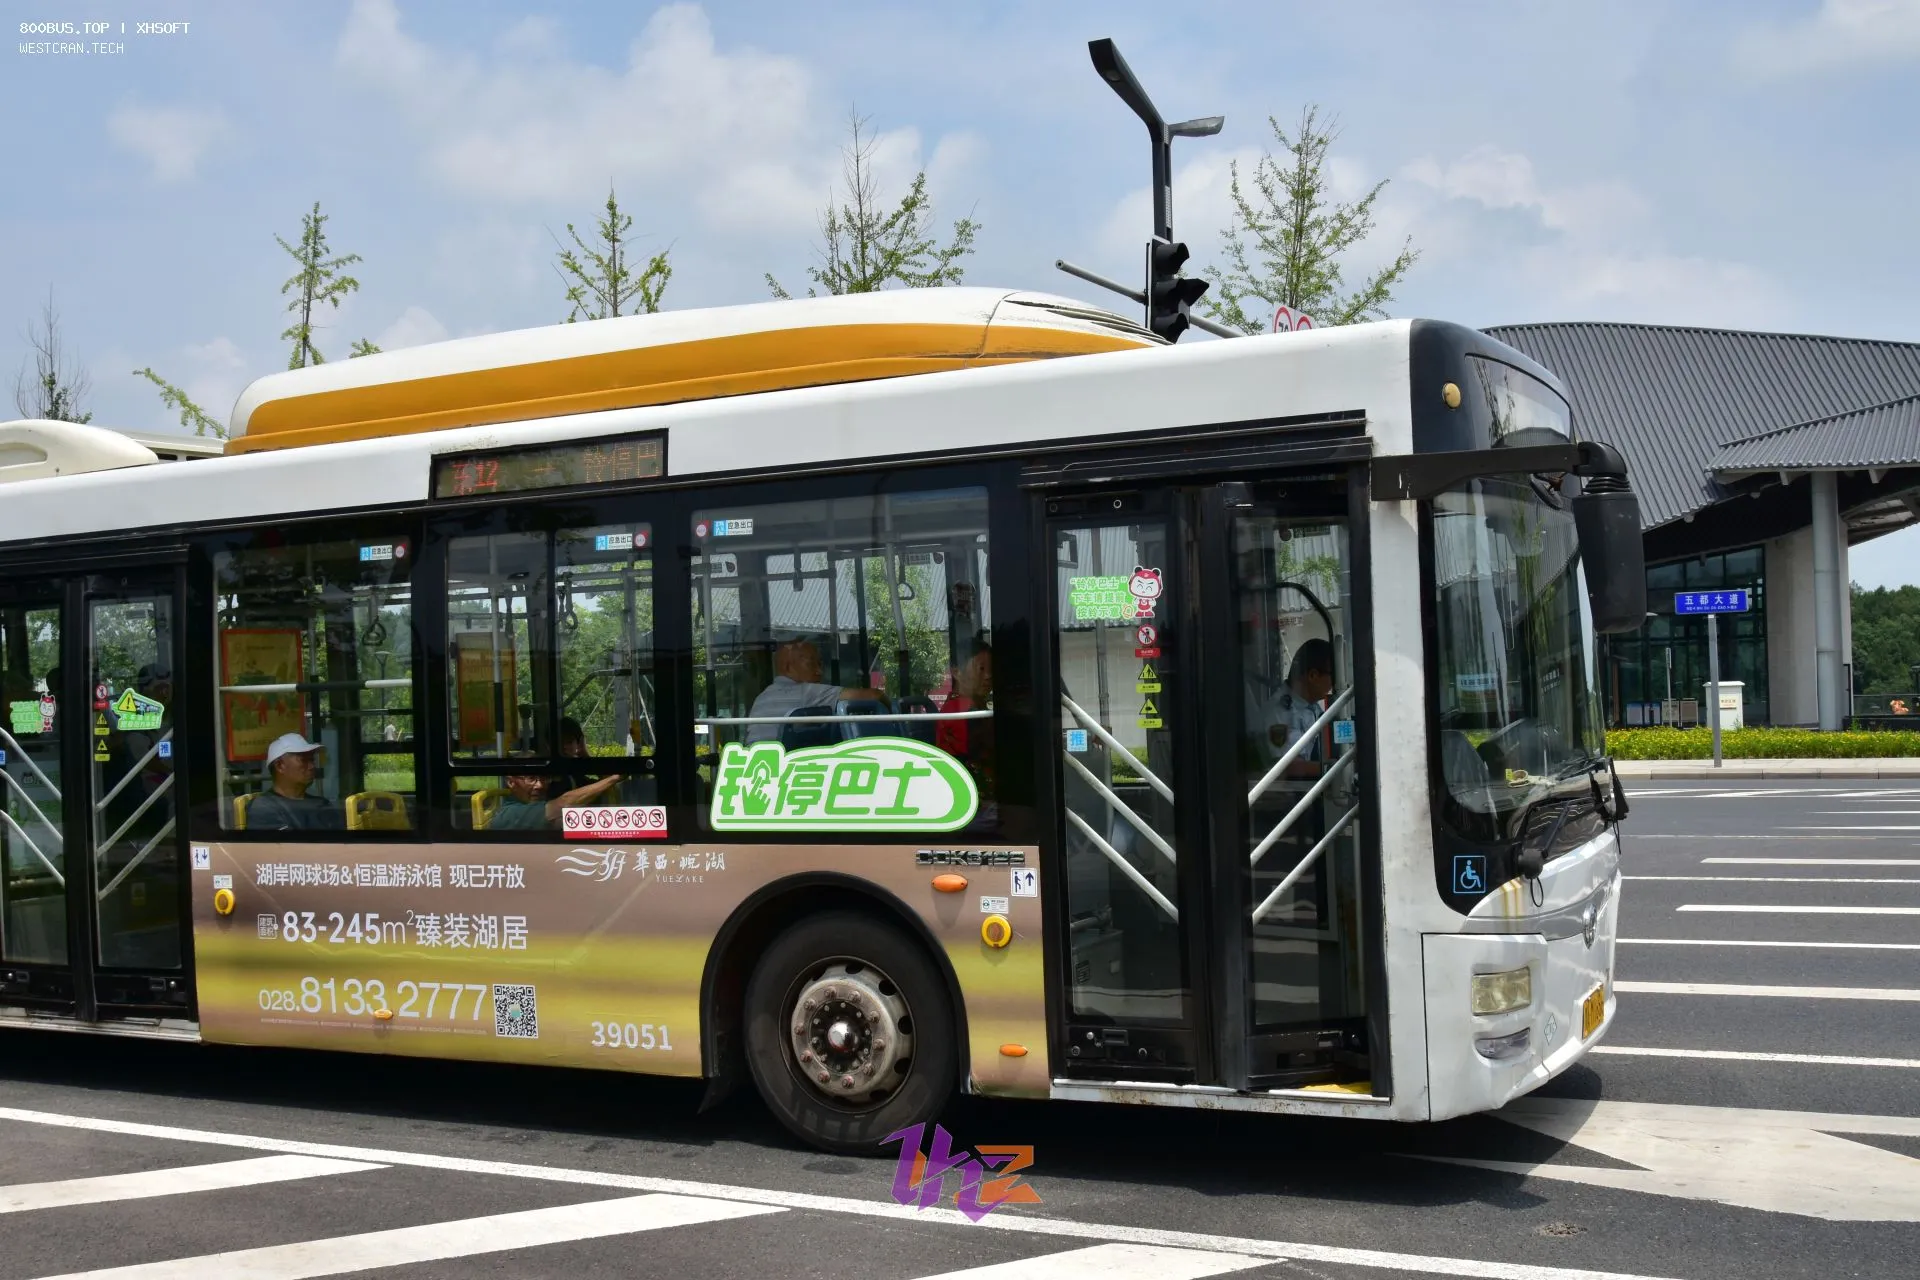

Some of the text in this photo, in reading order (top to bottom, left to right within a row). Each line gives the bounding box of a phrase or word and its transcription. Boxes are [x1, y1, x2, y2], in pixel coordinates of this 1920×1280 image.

[728, 521, 753, 530] 应急出口
[1684, 594, 1739, 605] 五都大道
[1070, 730, 1085, 745] 推
[1337, 722, 1352, 738] 推
[718, 749, 932, 815] 铃停巴士
[256, 863, 525, 889] 湖岸网球场&恒温游泳馆 现已开放
[591, 1021, 673, 1051] 39051
